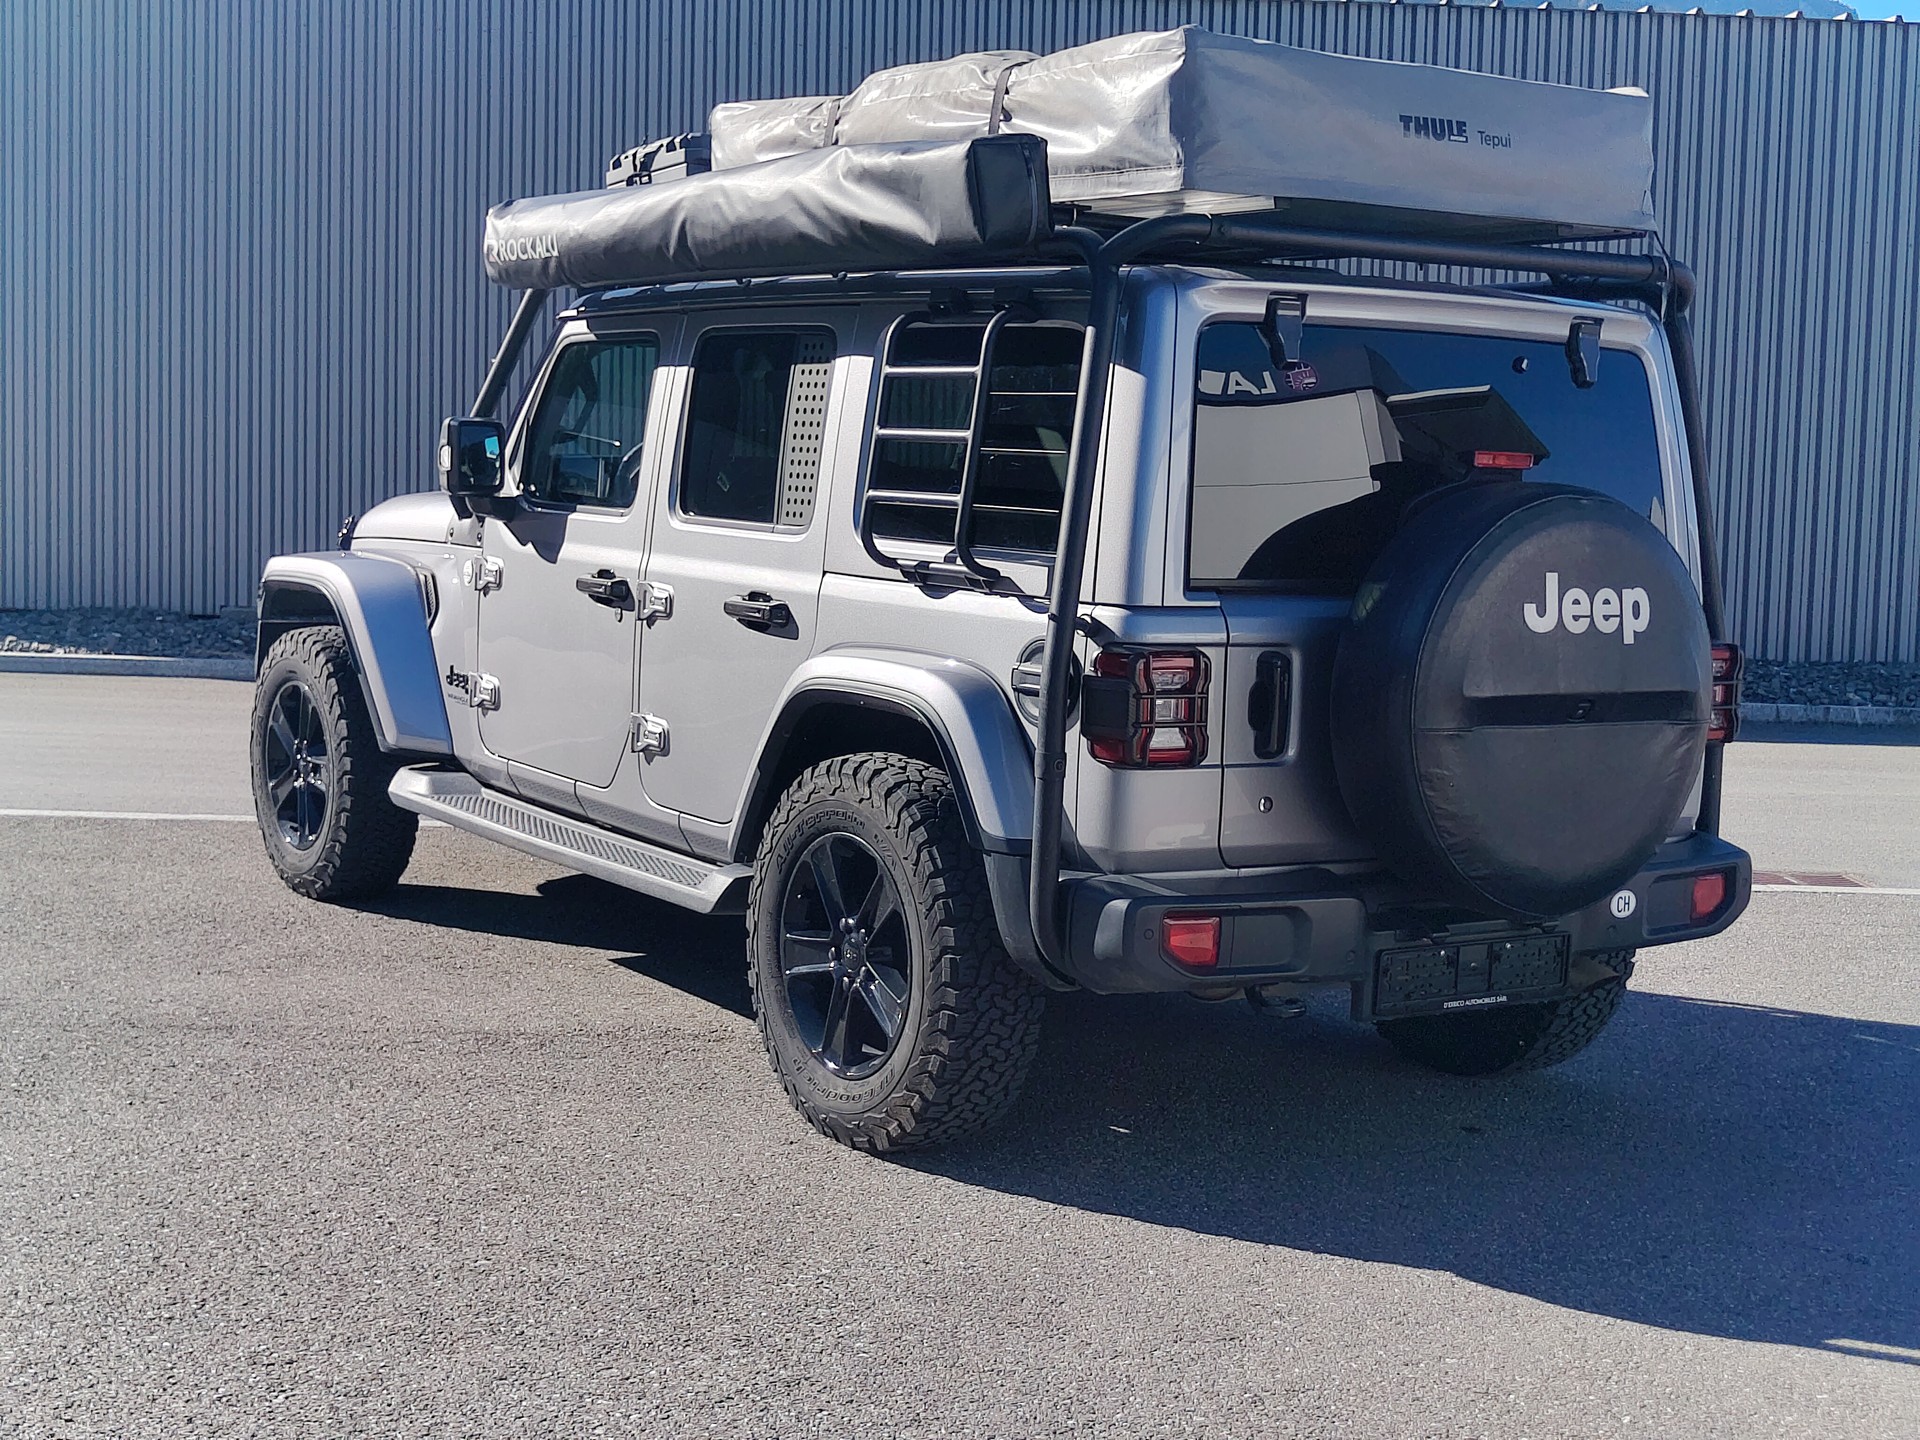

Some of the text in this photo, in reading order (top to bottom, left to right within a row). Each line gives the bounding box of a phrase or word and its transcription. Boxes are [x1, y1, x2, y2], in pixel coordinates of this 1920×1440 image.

[1399, 113, 1512, 149] THULE Tepui
[500, 234, 559, 262] ROCKALU
[1523, 572, 1650, 645] Jeep
[1616, 895, 1631, 913] CH
